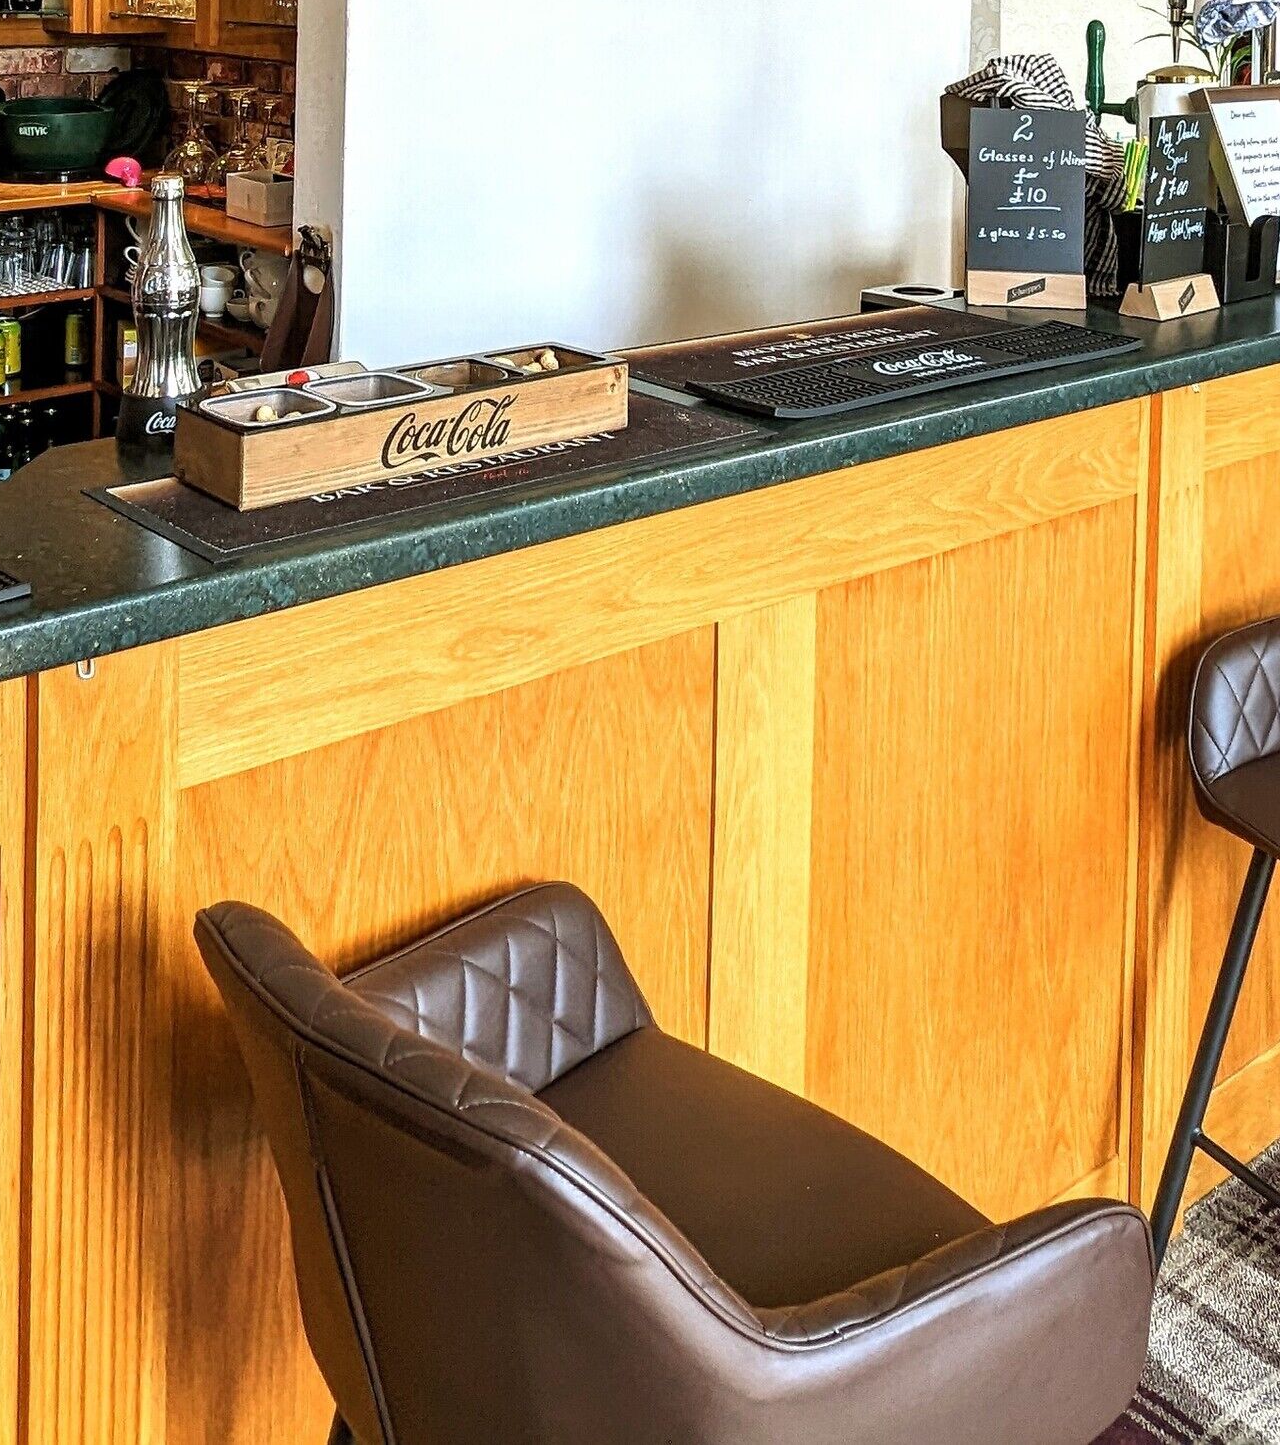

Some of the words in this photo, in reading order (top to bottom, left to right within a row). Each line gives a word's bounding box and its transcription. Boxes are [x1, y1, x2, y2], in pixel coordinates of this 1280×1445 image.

[1230, 110, 1241, 120] Dear
[1012, 114, 1034, 142] 2
[978, 146, 1034, 163] Glasses
[1042, 150, 1055, 170] of
[1060, 149, 1087, 166] Wine
[1013, 167, 1039, 185] for
[1008, 186, 1047, 204] £10
[978, 227, 986, 238] 1
[990, 226, 1020, 242] glass
[734, 355, 783, 368] BAR
[785, 351, 807, 360] &
[808, 329, 939, 356] RESTAURANT
[872, 348, 974, 375] Coca-Cola
[380, 391, 519, 468] Coca-Cola
[310, 480, 380, 503] BAR
[422, 429, 618, 480] RESTAURANT
